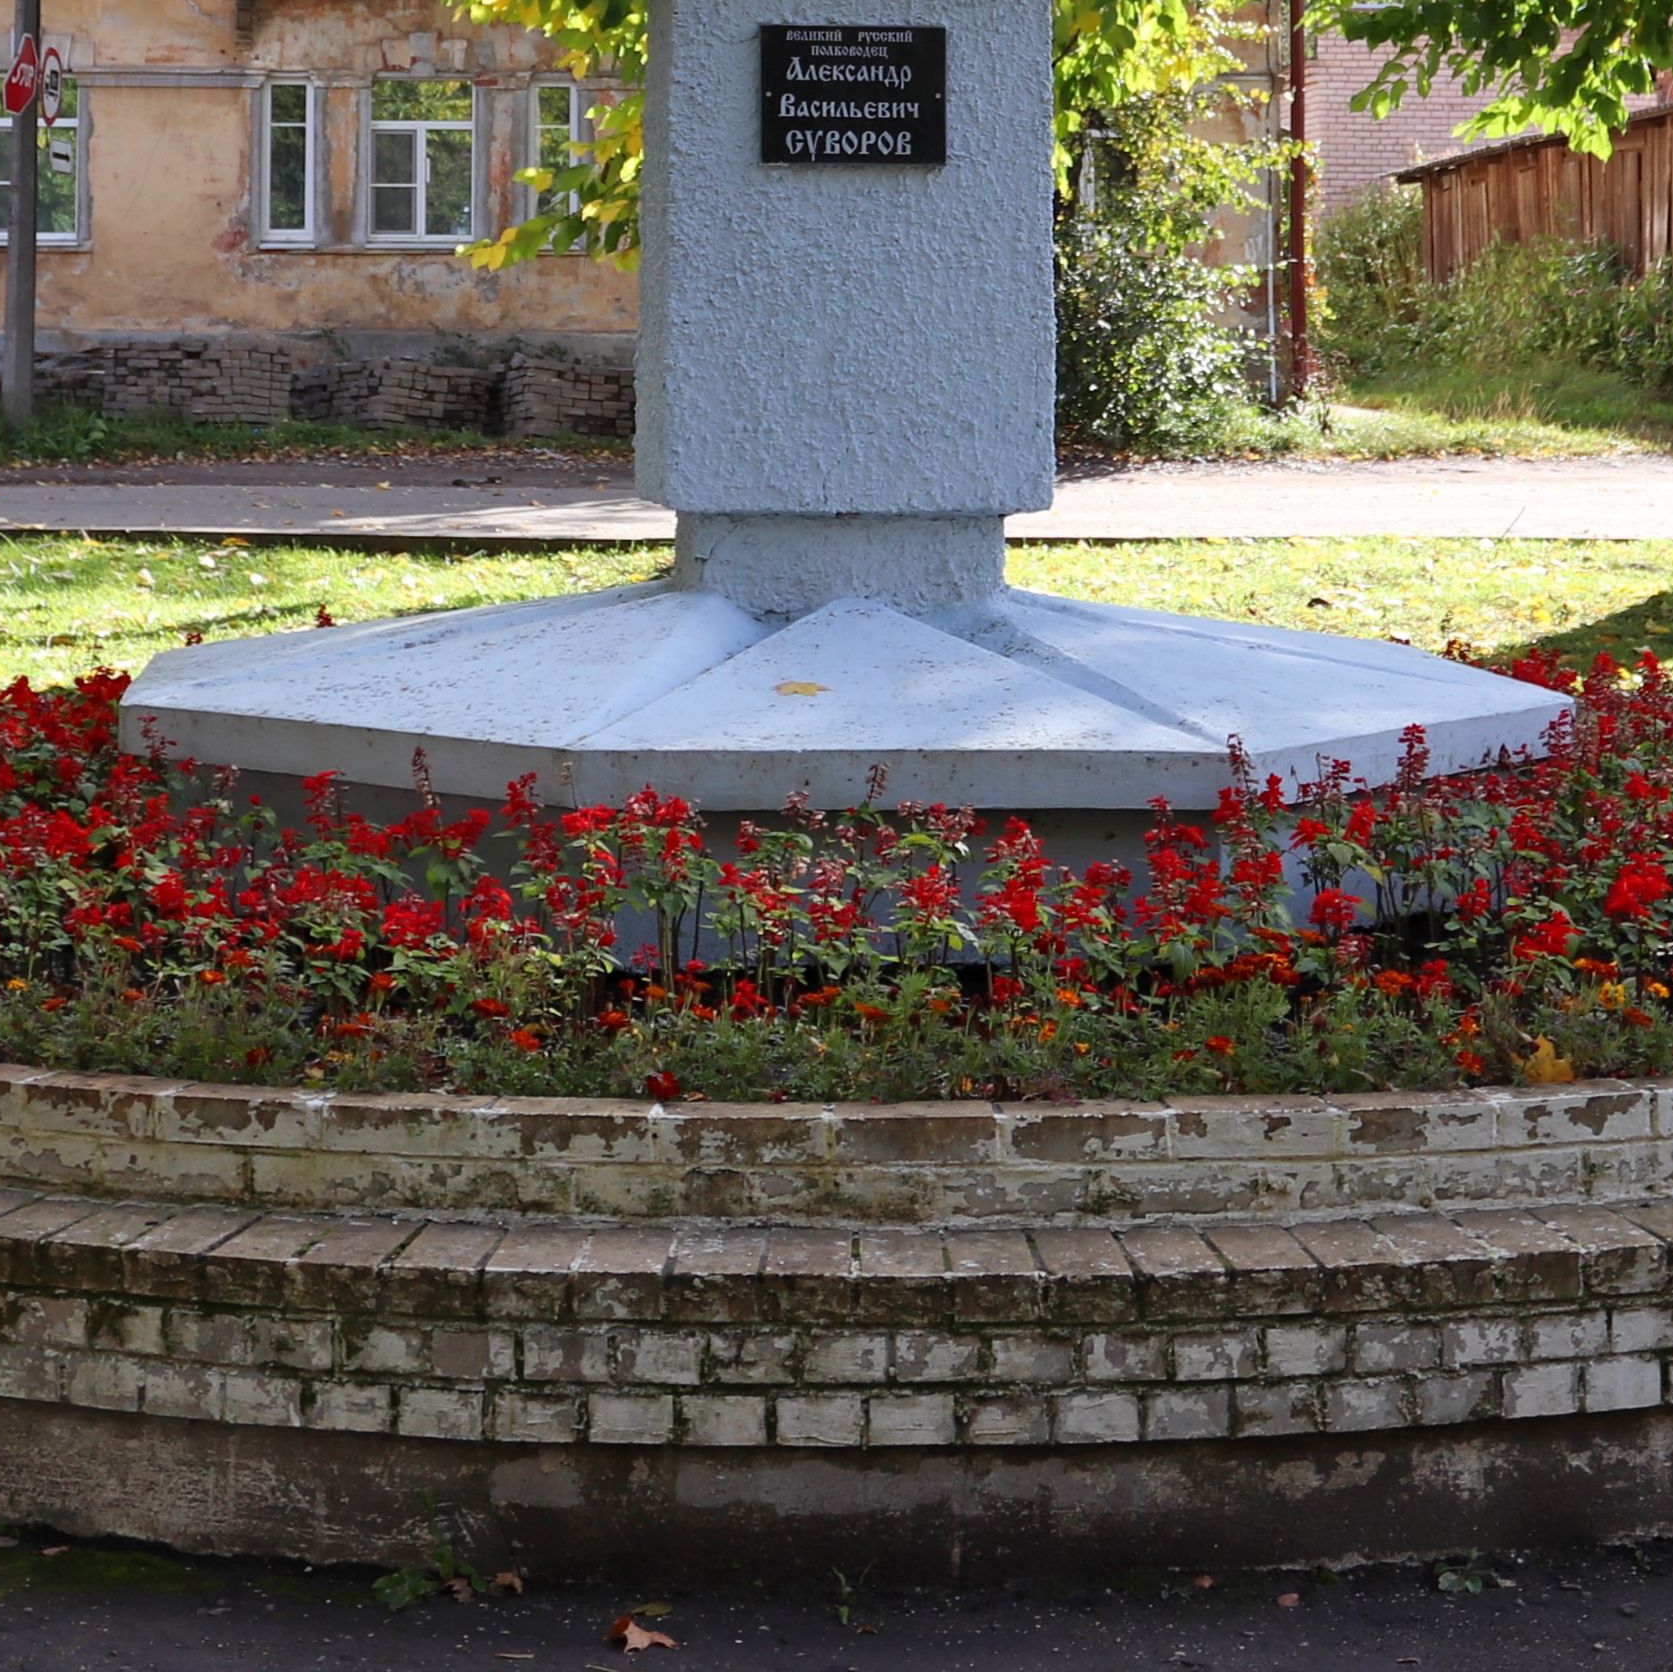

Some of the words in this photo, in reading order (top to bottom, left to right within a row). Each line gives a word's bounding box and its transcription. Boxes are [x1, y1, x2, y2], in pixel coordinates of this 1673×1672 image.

[785, 29, 842, 42] ВЕЛИКИЙ
[857, 30, 913, 44] РУССКИЙ
[810, 45, 889, 58] ПОЛКОВОДЕЦ
[11, 62, 34, 88] STOP
[785, 130, 912, 162] СУВОРОВ
